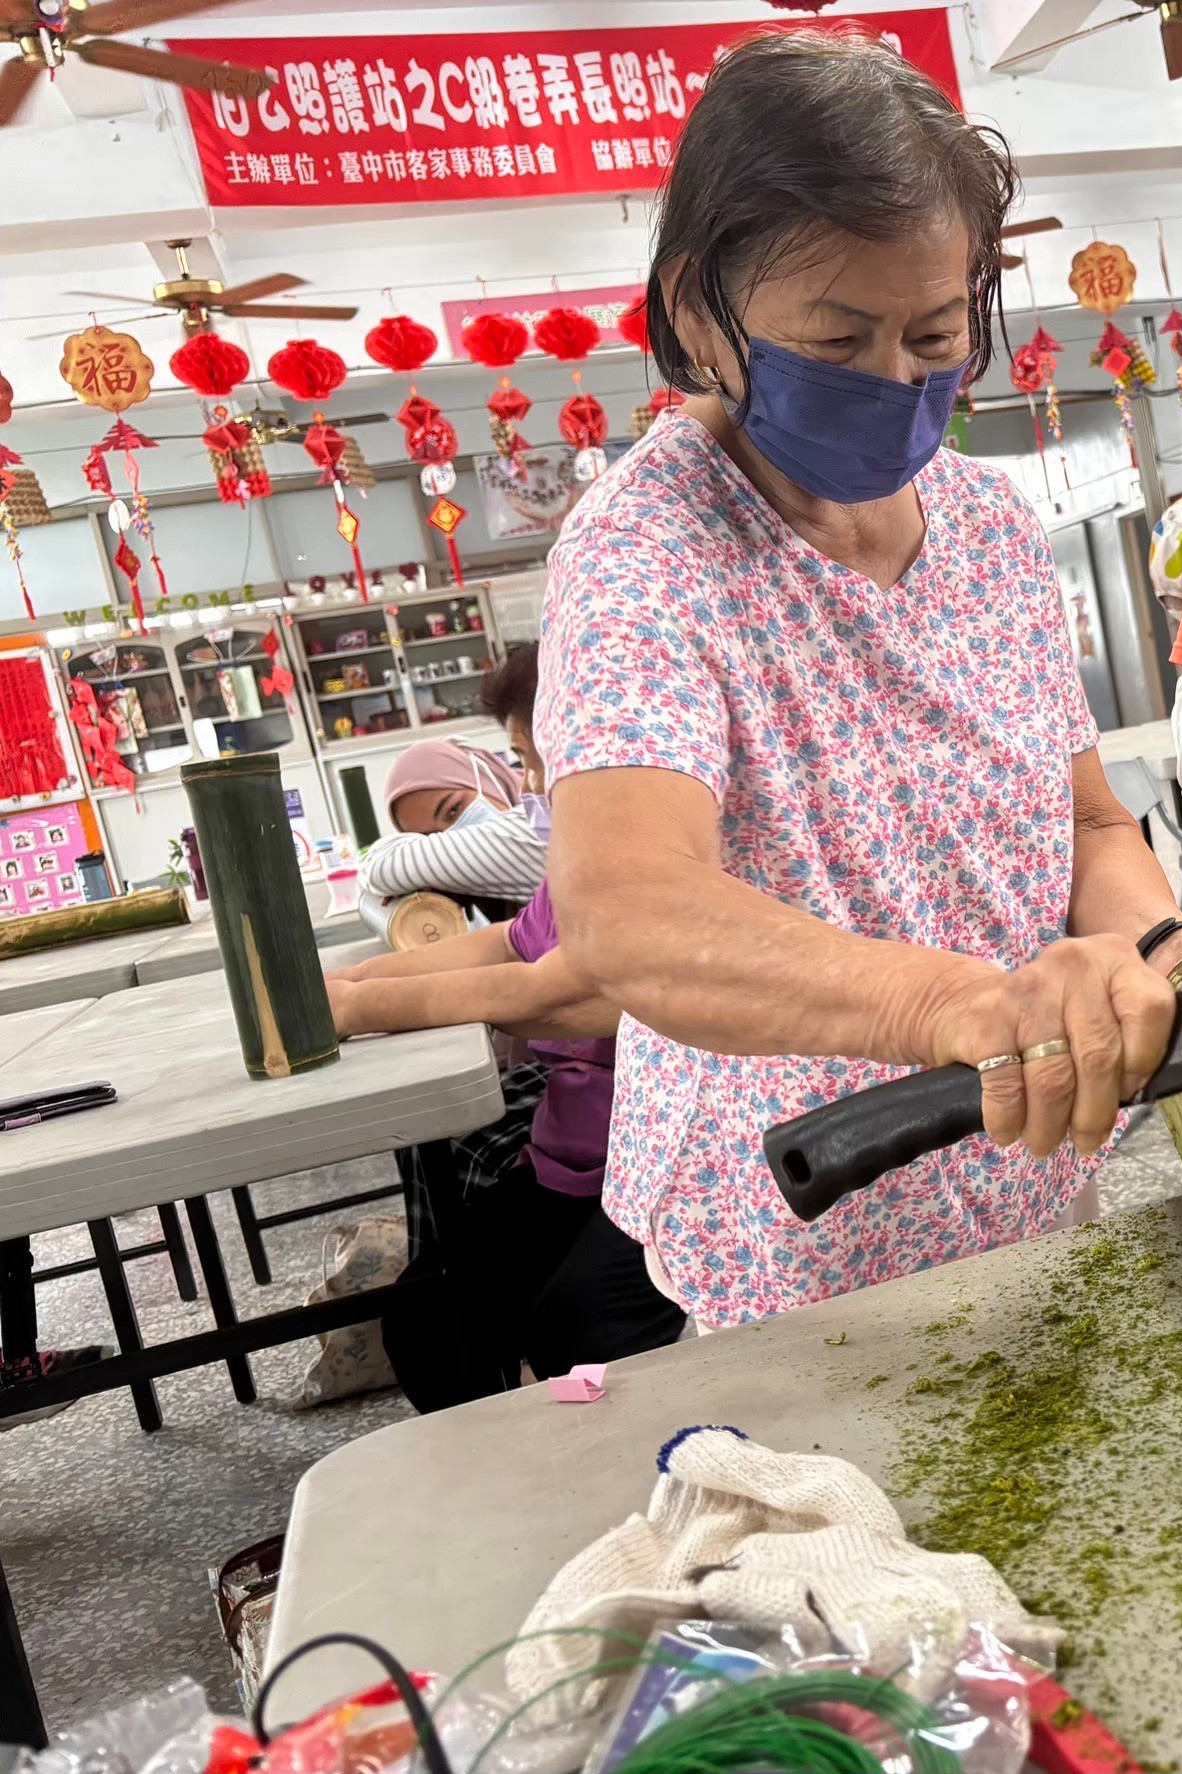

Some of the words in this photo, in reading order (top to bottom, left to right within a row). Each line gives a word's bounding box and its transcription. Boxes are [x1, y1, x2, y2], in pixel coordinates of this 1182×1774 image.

[223, 142, 557, 186] 主辦單位：臺中市客家事務委員會
[1079, 254, 1123, 302] 福
[75, 342, 137, 397] 福
